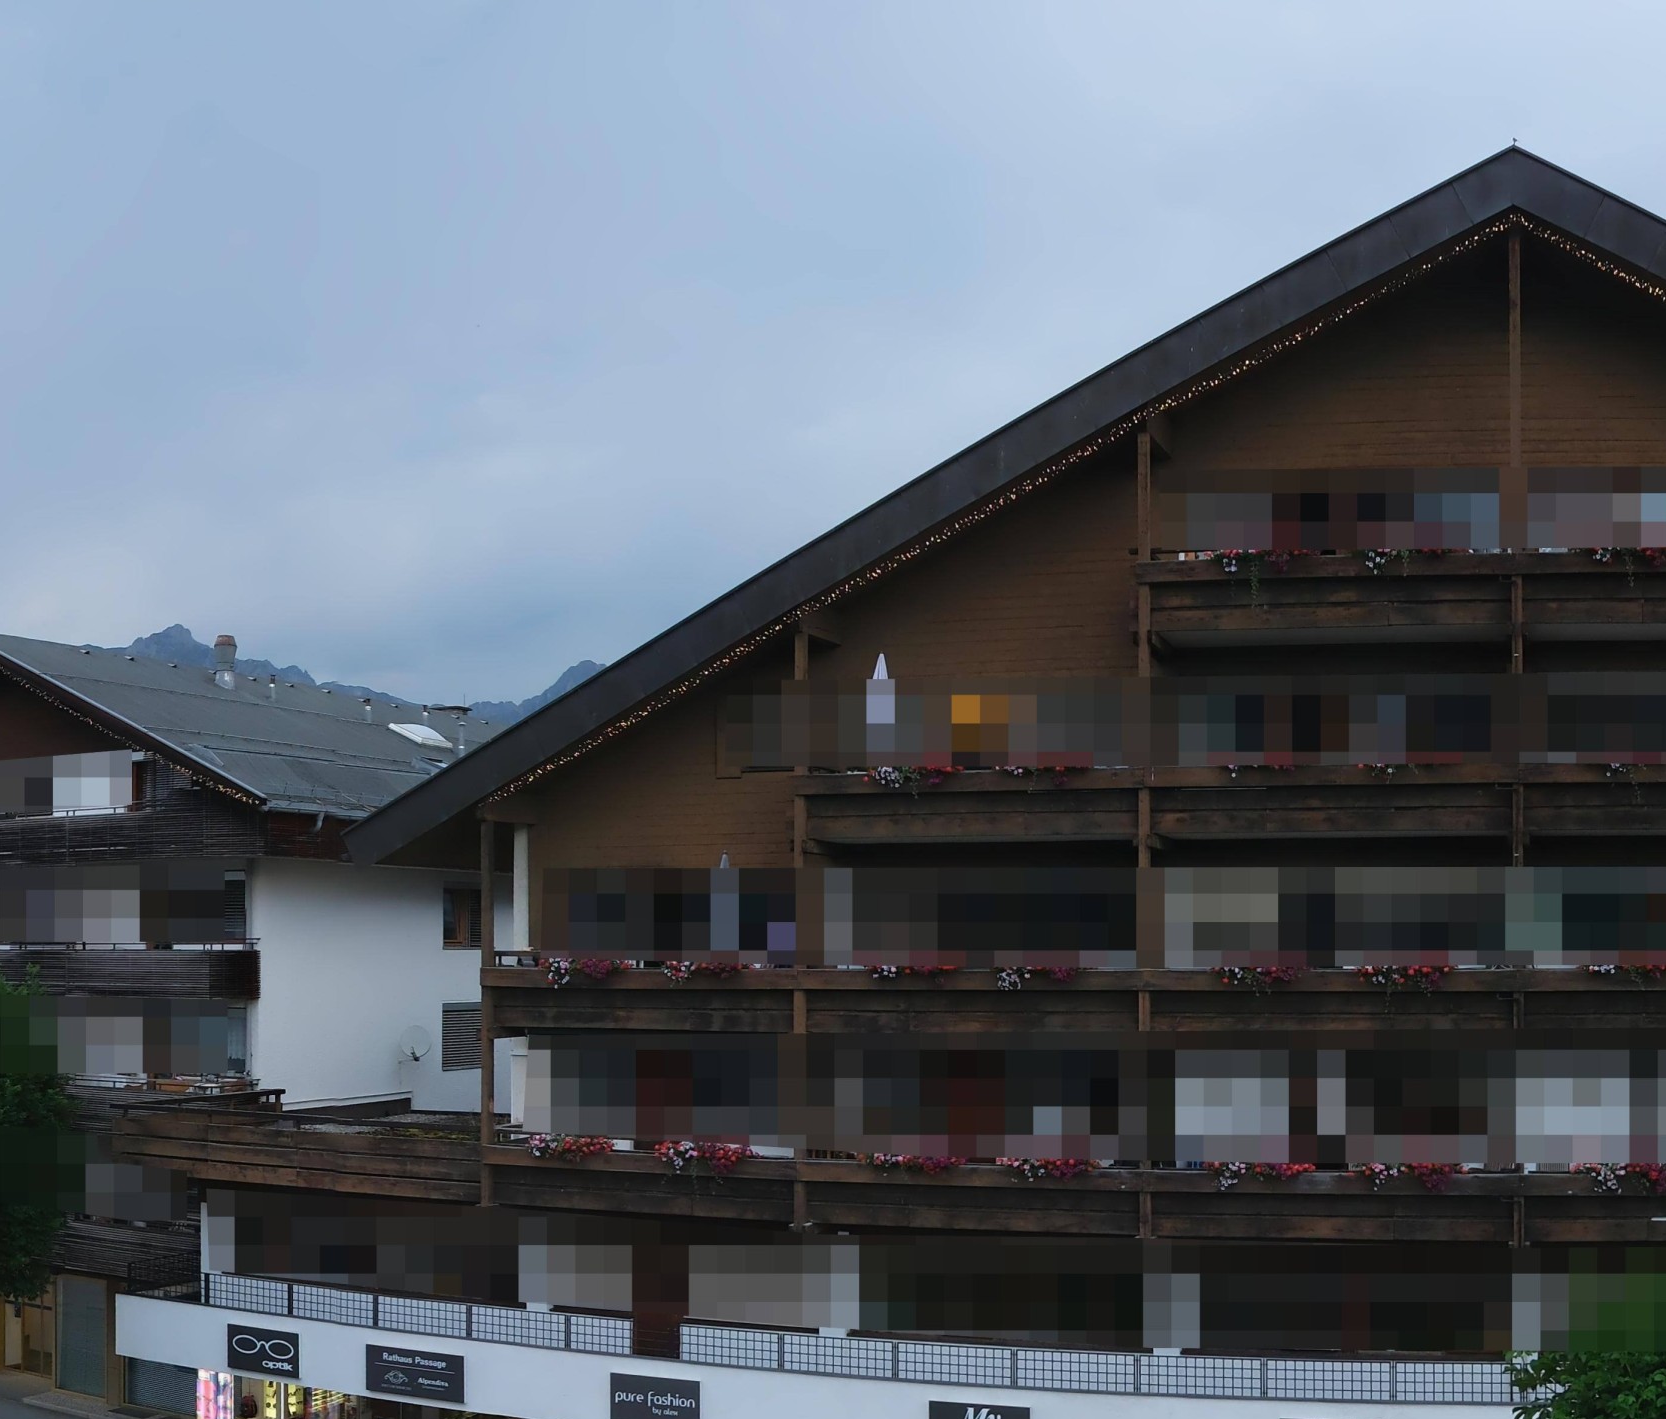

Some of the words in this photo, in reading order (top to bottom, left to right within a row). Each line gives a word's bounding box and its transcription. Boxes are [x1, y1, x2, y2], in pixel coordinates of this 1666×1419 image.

[261, 1359, 294, 1372] optik
[382, 1352, 413, 1364] Rathaus
[414, 1356, 447, 1369] Passage
[614, 1390, 644, 1403] pure
[648, 1391, 696, 1409] fashion
[652, 1406, 662, 1416] by
[663, 1408, 679, 1416] alex
